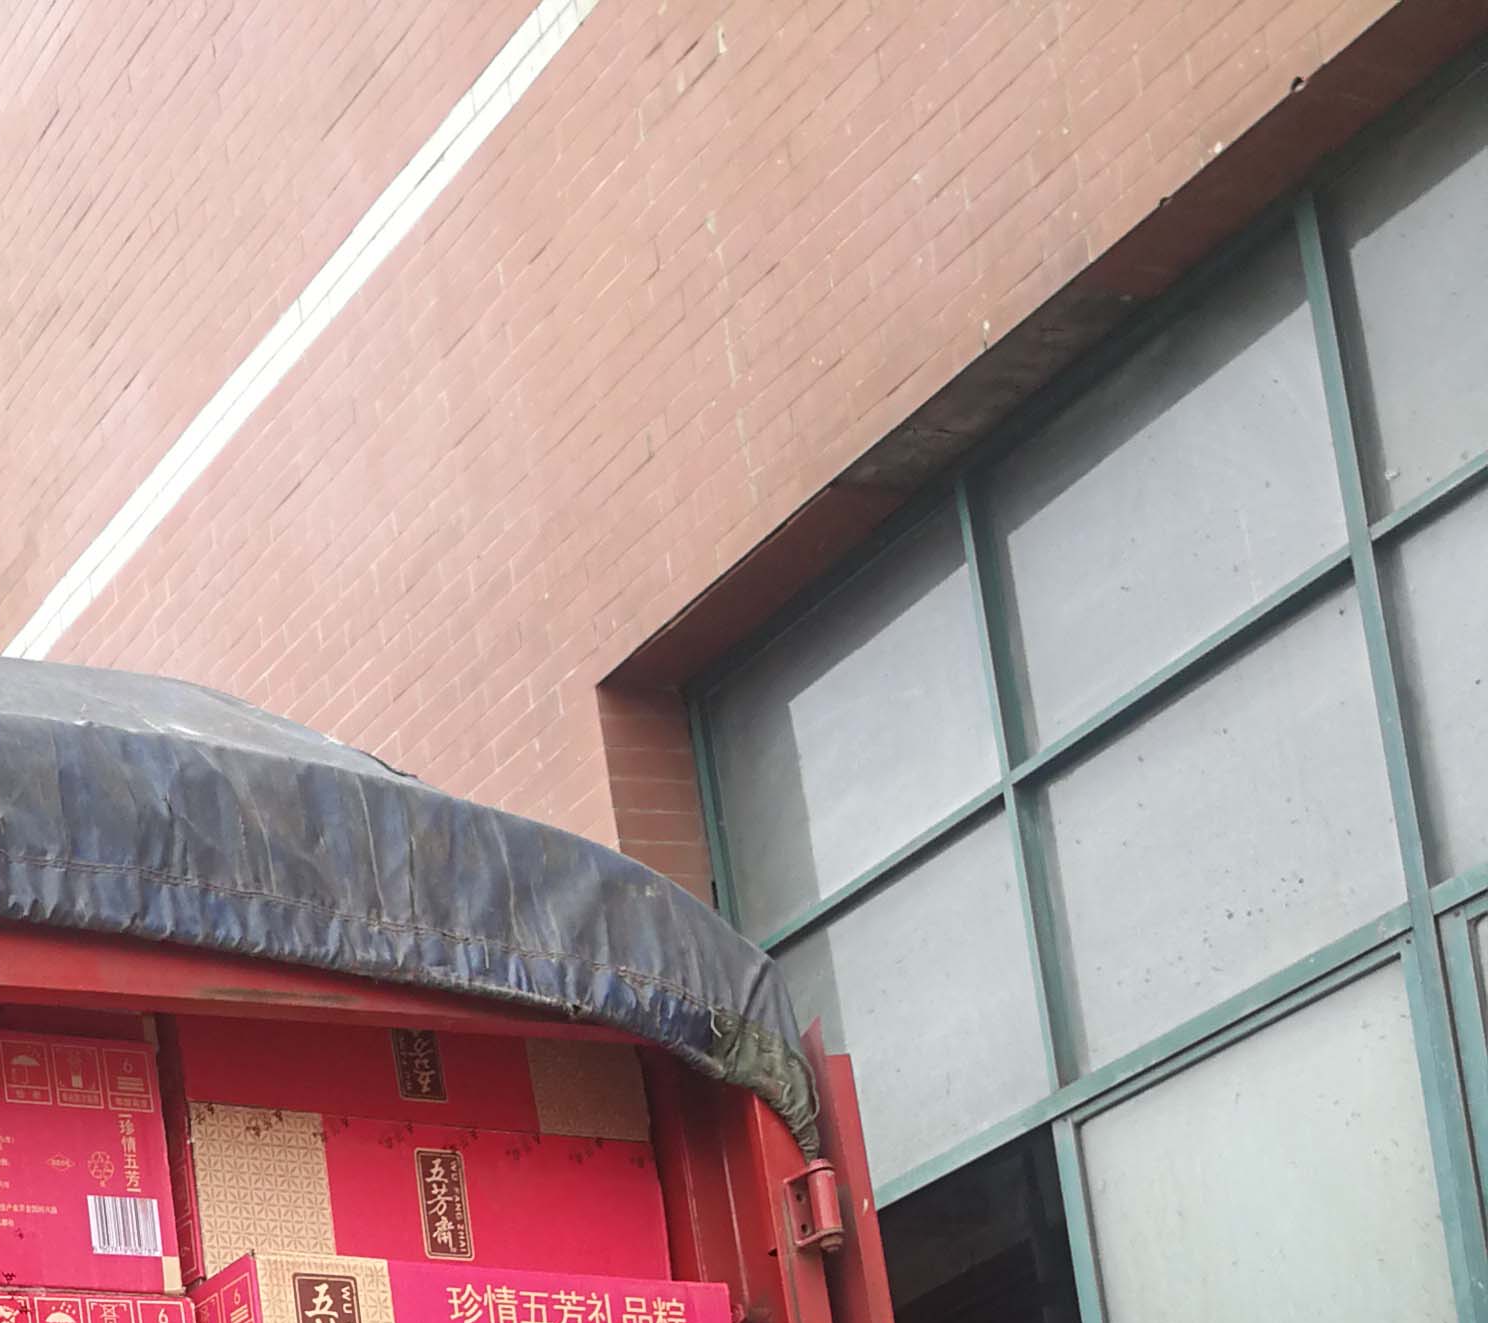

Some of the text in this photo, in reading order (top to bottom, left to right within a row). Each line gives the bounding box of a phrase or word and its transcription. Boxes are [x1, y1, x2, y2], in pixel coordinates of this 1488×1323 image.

[118, 1119, 140, 1187] 珍情五芳
[233, 1288, 241, 1304] 6
[340, 1286, 352, 1313] WU
